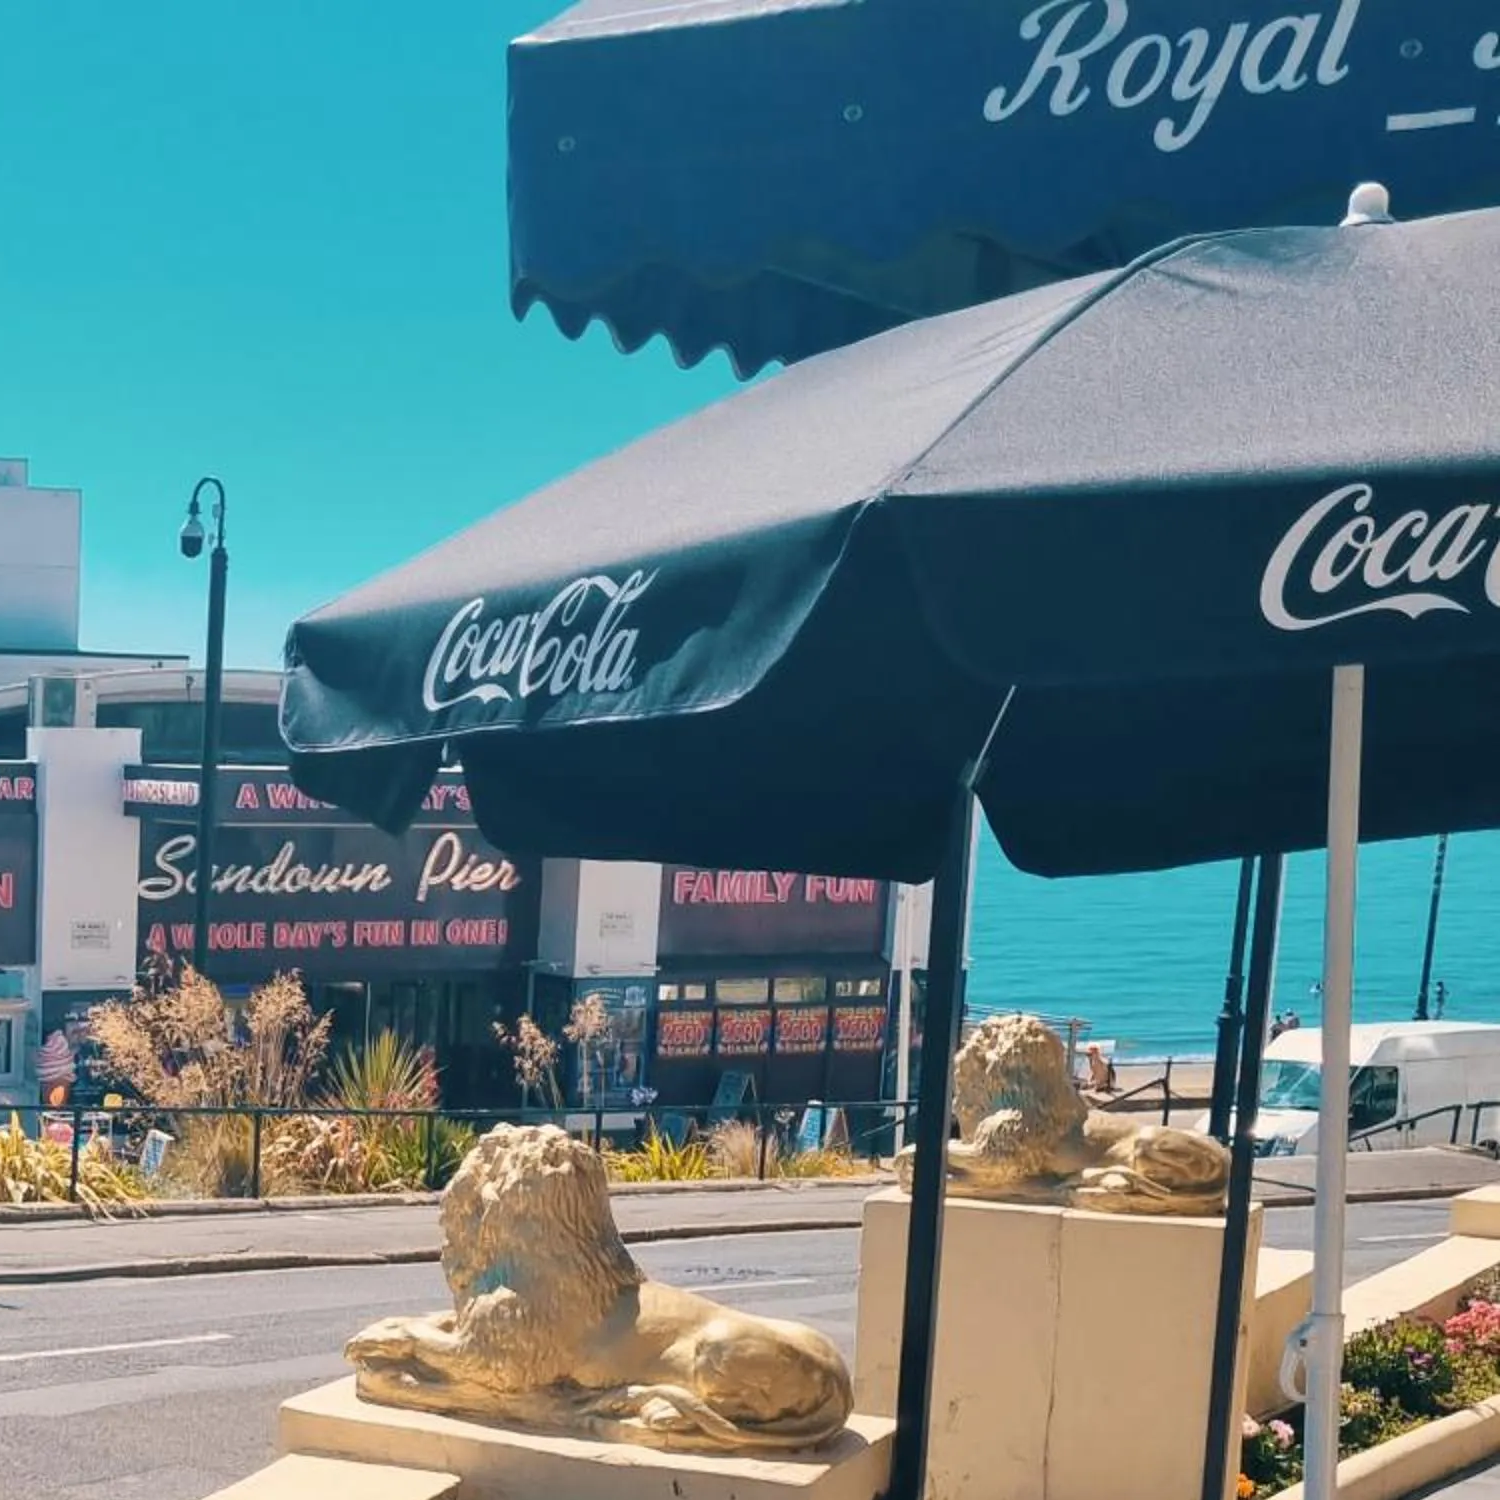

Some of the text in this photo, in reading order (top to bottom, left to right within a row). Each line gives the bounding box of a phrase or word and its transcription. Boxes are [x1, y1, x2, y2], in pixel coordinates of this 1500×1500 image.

[983, 0, 1362, 152] Royal
[1259, 482, 1500, 631] Coca
[422, 567, 660, 712] Coca-Cola
[235, 783, 260, 809] A
[416, 831, 521, 902] Pier
[674, 871, 875, 904] FAMILY FUN
[148, 924, 167, 951] A
[274, 920, 347, 949] DAY'S
[354, 919, 405, 947] FUN
[411, 918, 439, 946] IN
[446, 917, 508, 946] ONE!
